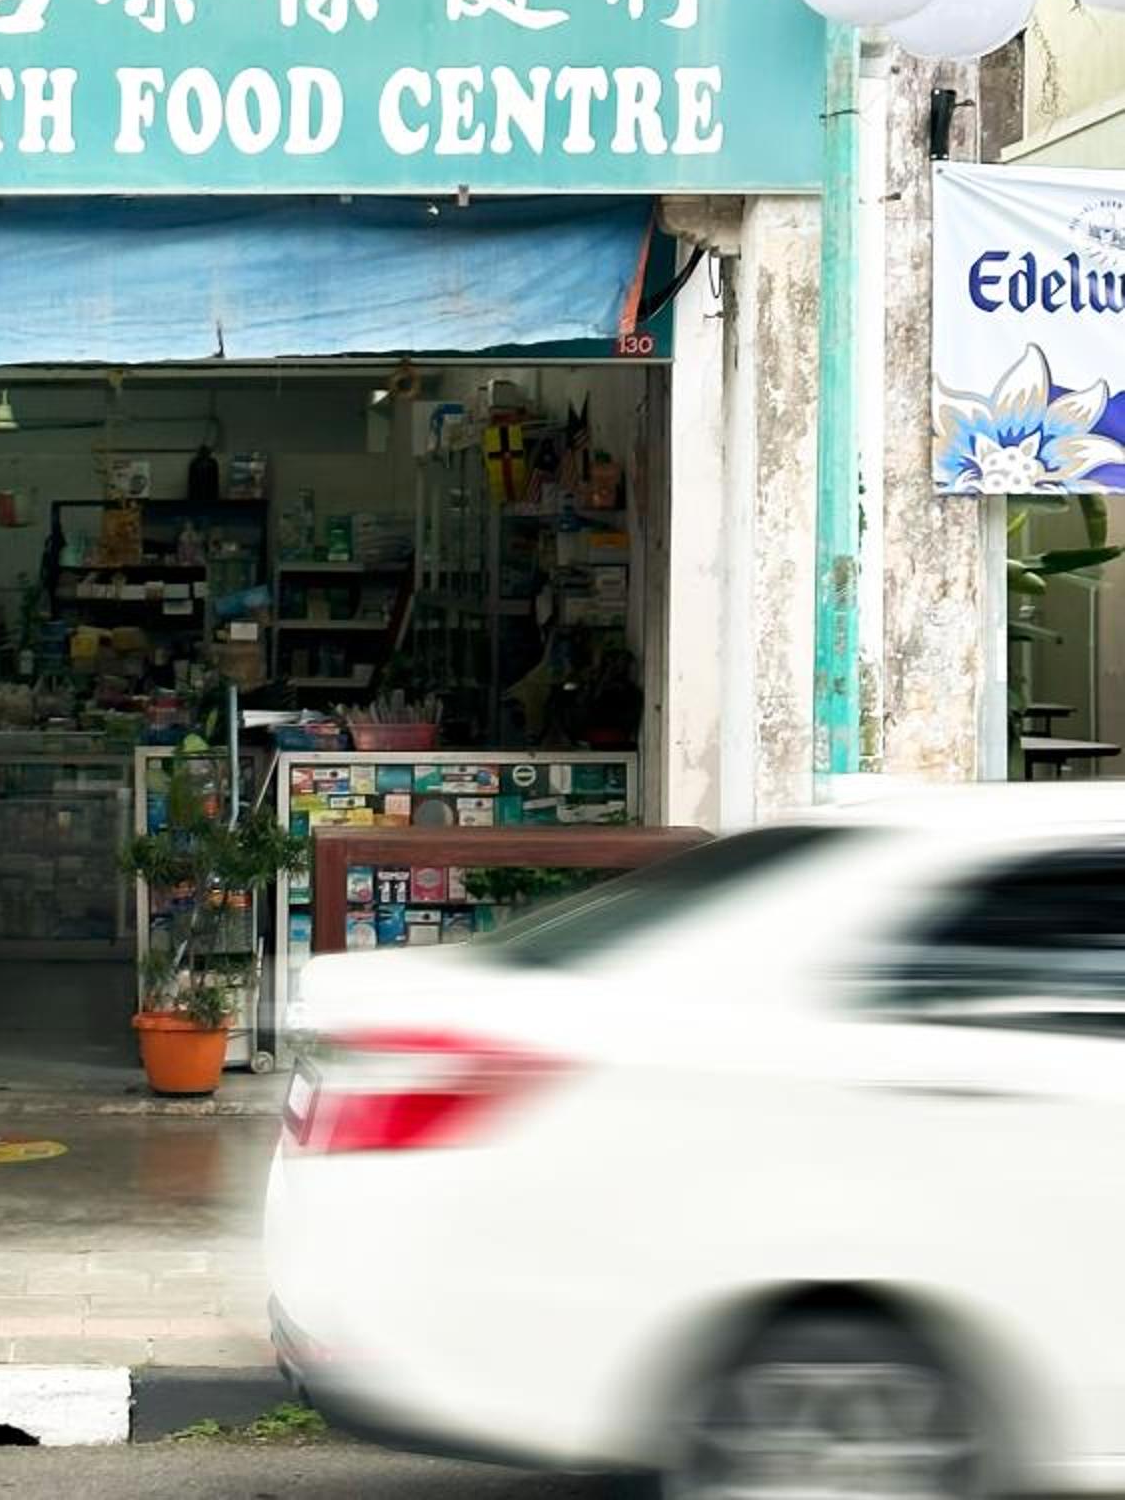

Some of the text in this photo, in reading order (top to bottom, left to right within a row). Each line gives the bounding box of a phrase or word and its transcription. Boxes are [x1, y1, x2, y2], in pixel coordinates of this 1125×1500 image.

[114, 65, 345, 156] FOOD
[378, 64, 724, 156] CENTRE
[619, 334, 653, 353] 130
